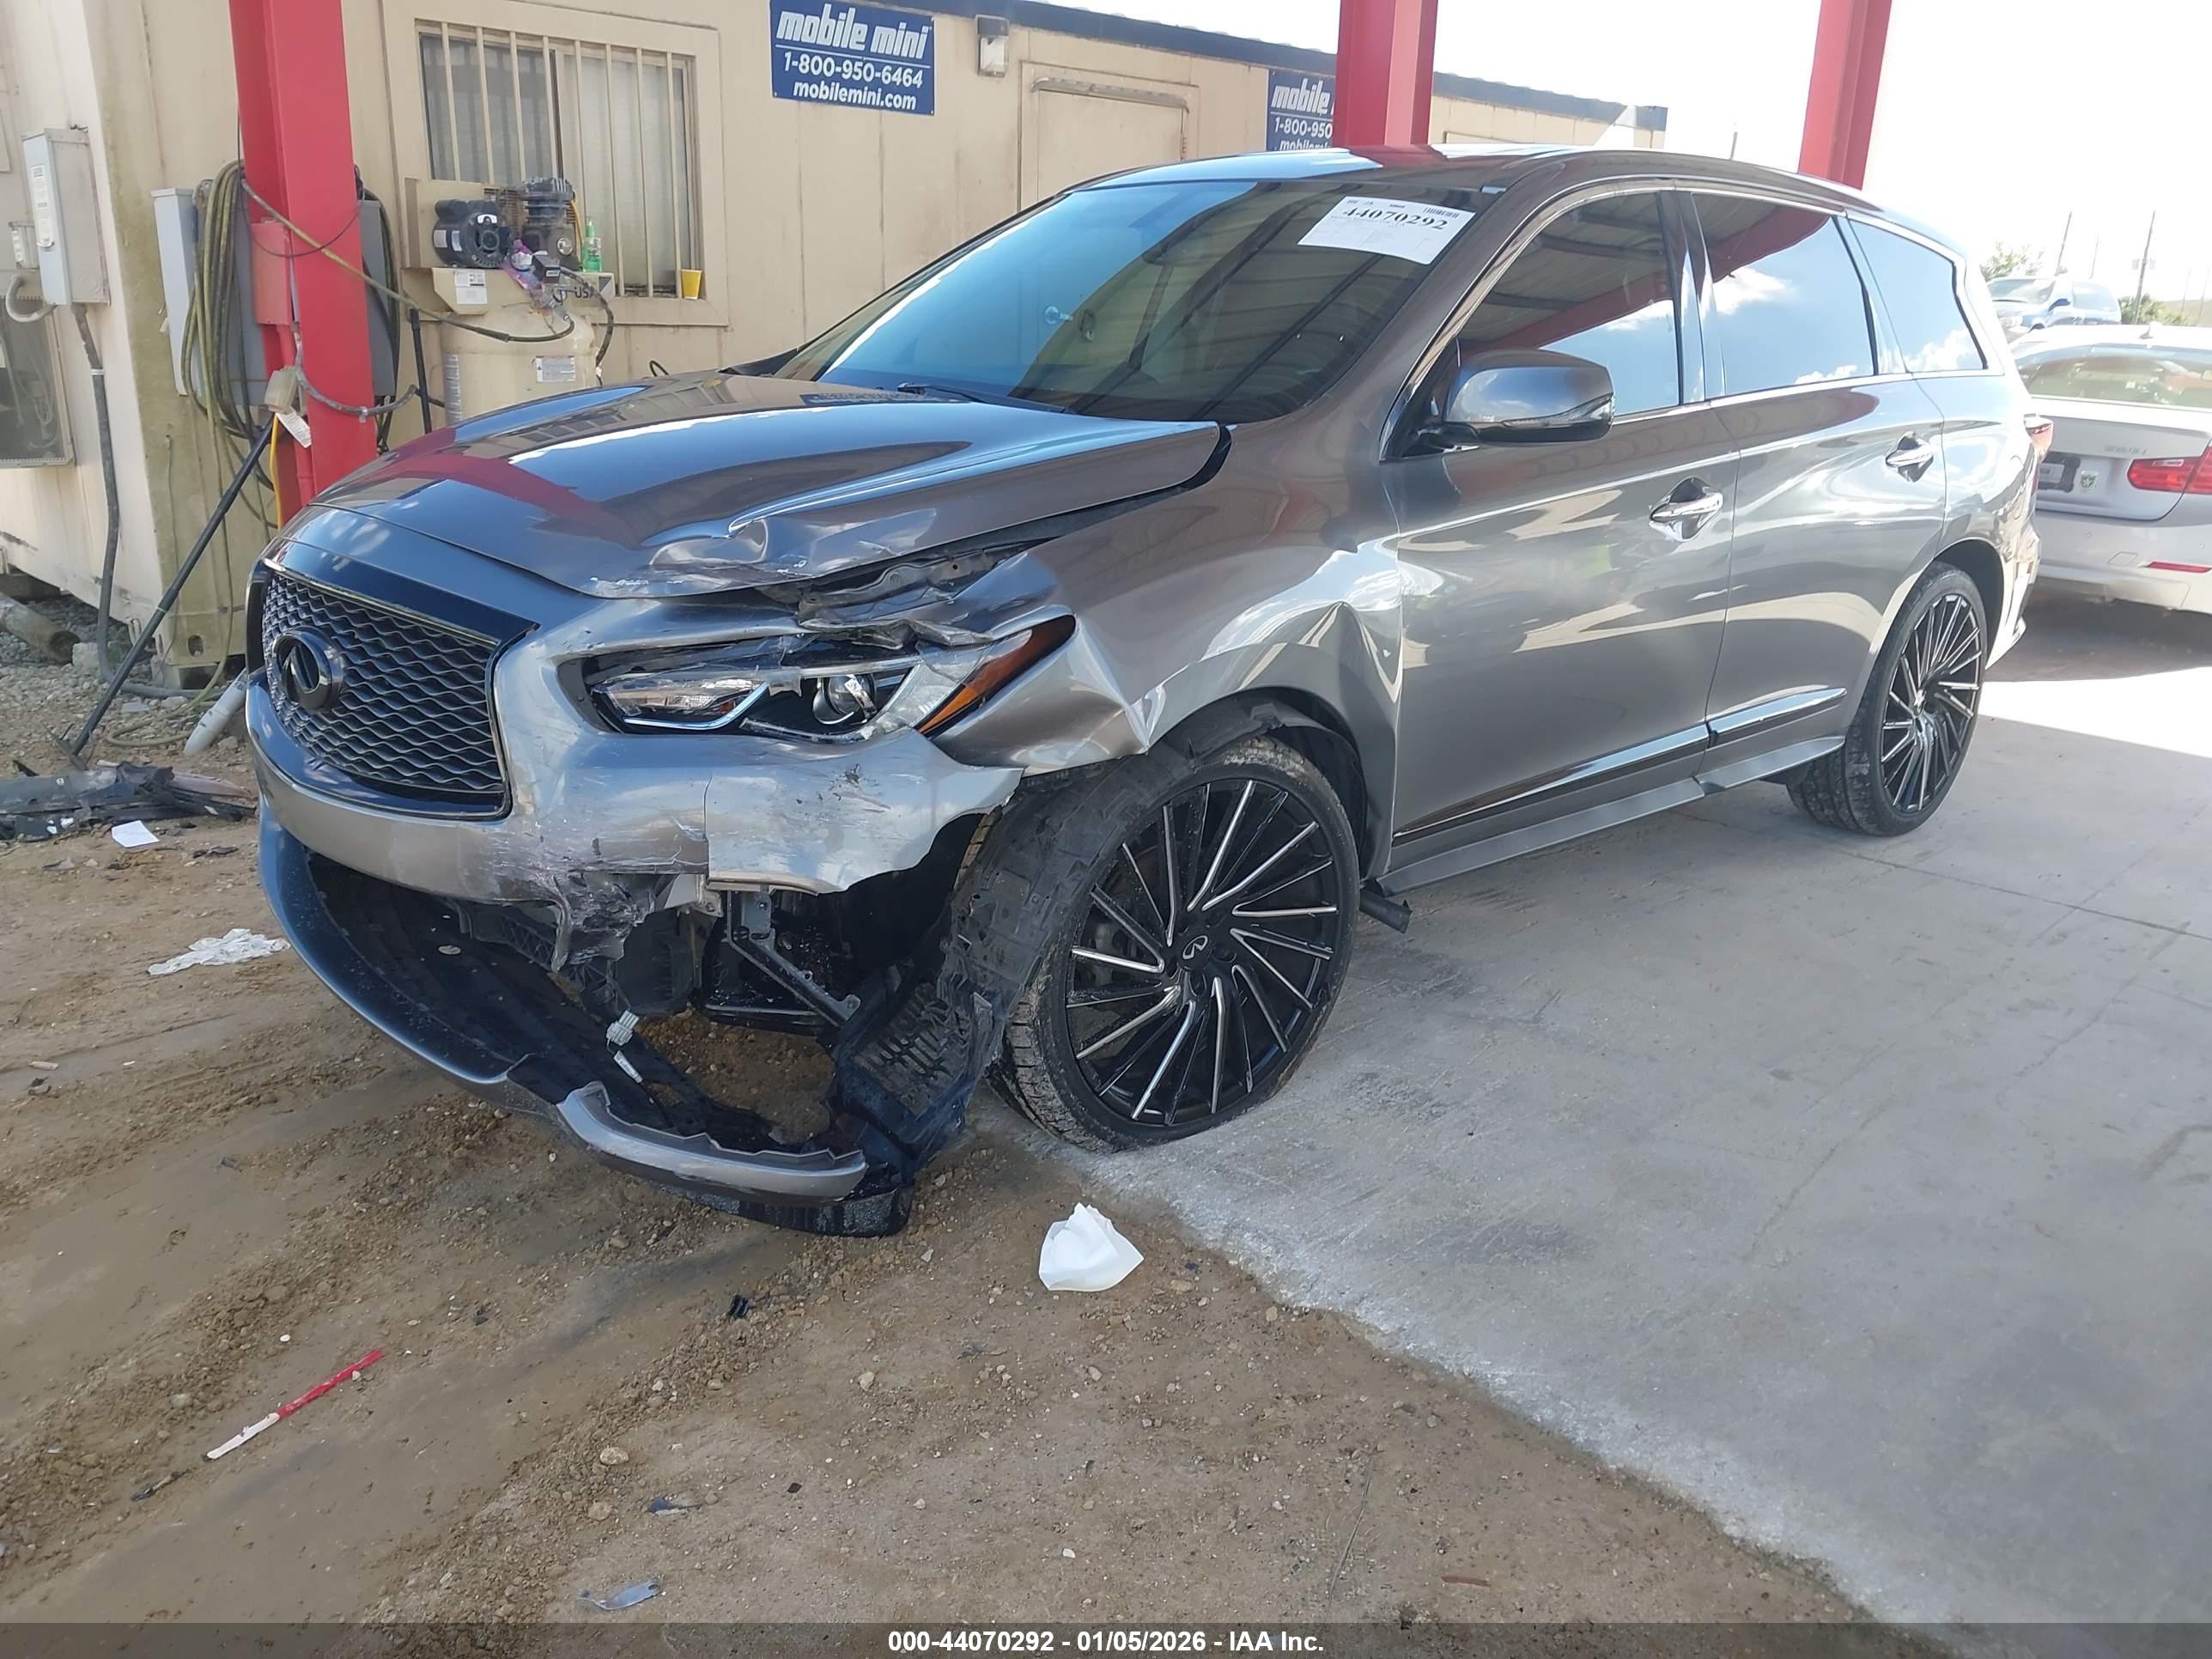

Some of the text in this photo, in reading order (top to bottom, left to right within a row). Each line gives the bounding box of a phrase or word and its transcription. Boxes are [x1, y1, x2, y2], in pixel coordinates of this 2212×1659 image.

[776, 3, 929, 59] mobile mini
[784, 52, 923, 88] 1-800-950-6464
[793, 81, 917, 110] mobilemini.com
[1271, 77, 1331, 115] mobile
